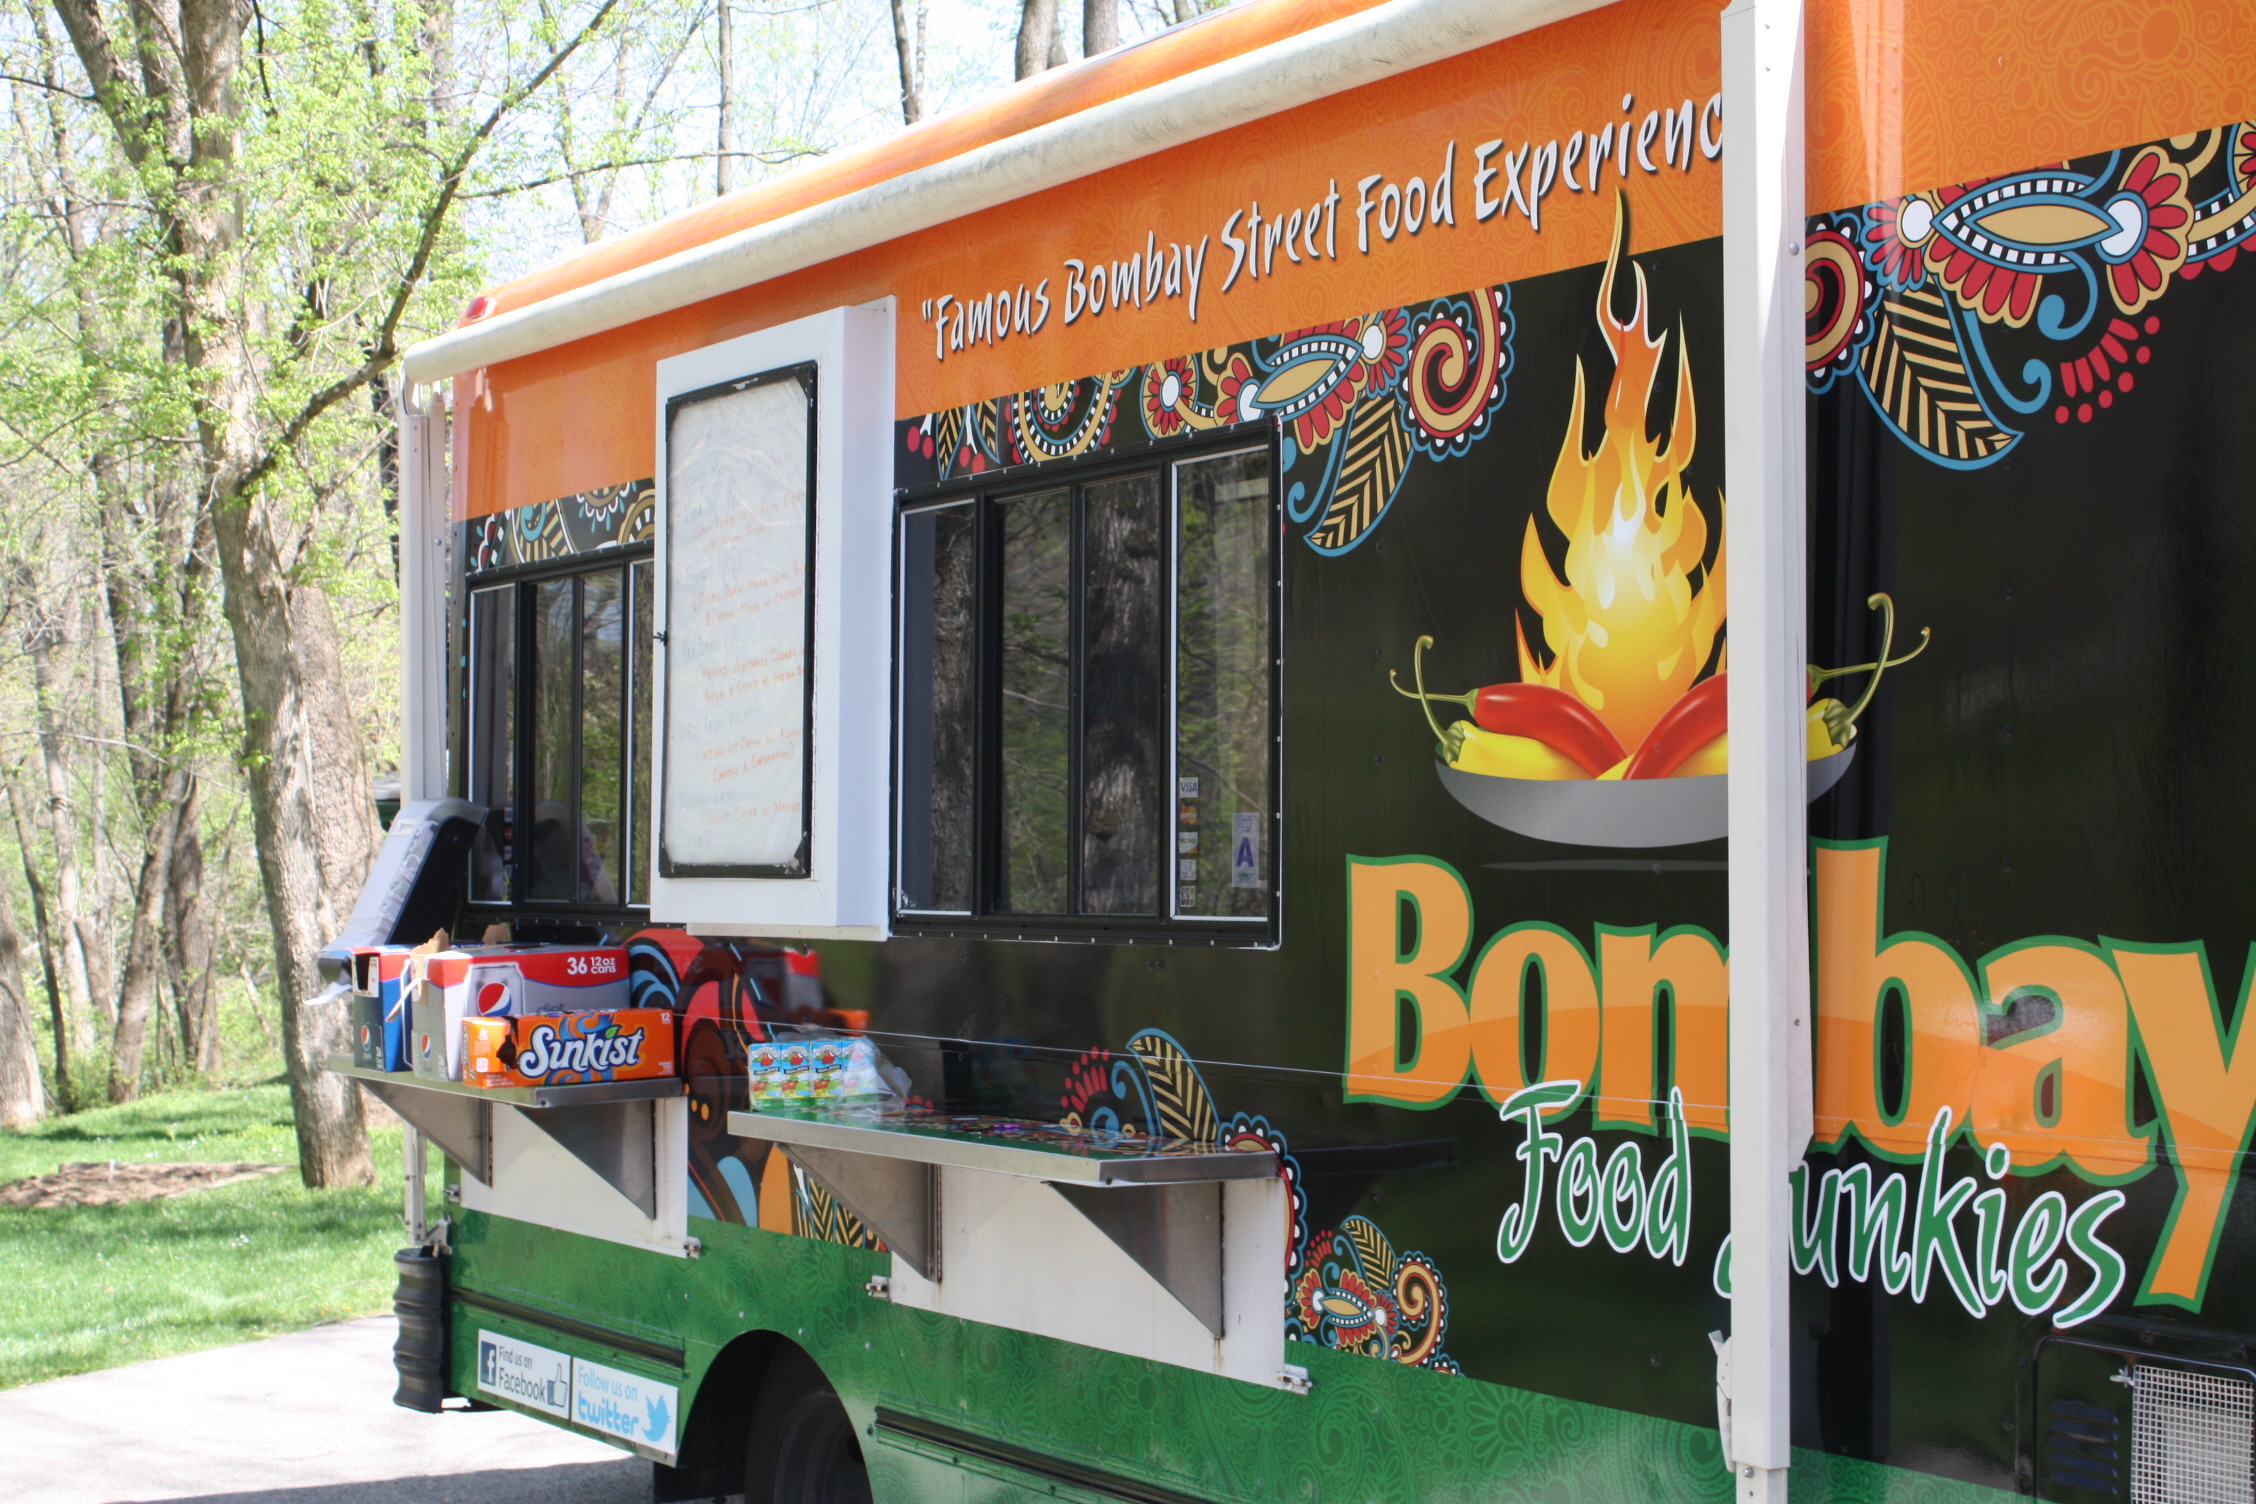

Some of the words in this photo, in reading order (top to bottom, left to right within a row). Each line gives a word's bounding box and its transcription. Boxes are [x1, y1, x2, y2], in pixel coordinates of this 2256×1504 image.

[922, 272, 1050, 361] "Famous
[1064, 231, 1210, 319] Bombay
[1220, 179, 1340, 292] Street
[1358, 140, 1456, 253] Food
[1474, 92, 1723, 230] Experienc
[1181, 783, 1198, 792] VISA
[1236, 836, 1254, 867] A
[566, 956, 588, 975] 36
[590, 965, 617, 974] cans
[518, 1025, 645, 1078] Sunkist
[1497, 1080, 1692, 1266] Food
[1713, 1105, 2126, 1328] unkies
[499, 1346, 514, 1364] Find
[515, 1354, 523, 1367] us
[524, 1356, 533, 1369] on
[498, 1367, 547, 1403] Facebook
[578, 1366, 609, 1394] Follow
[611, 1380, 623, 1398] us
[624, 1385, 638, 1402] on
[577, 1390, 640, 1435] twitter
